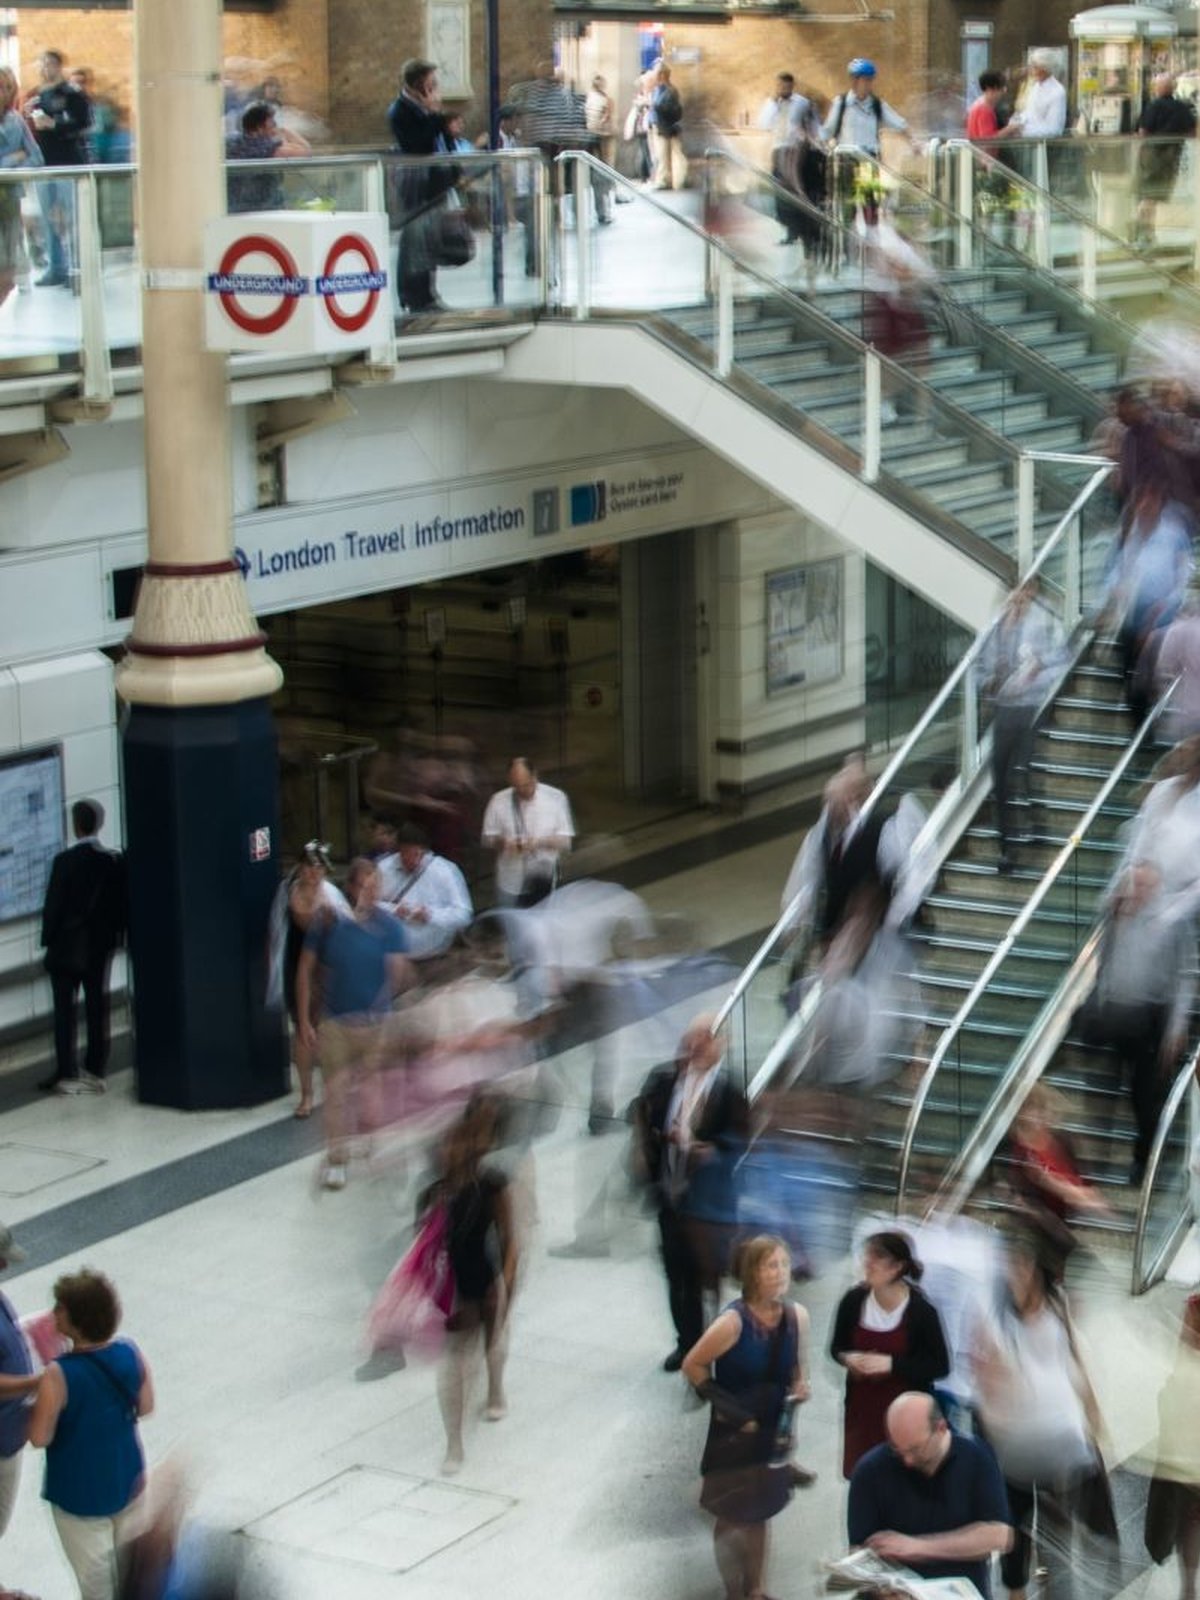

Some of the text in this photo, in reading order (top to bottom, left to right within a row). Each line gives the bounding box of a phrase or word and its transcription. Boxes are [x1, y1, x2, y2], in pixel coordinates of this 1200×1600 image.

[213, 275, 304, 294] UNDERGROUND
[319, 273, 385, 291] UNDERGROUND
[258, 505, 524, 577] London Travel Information
